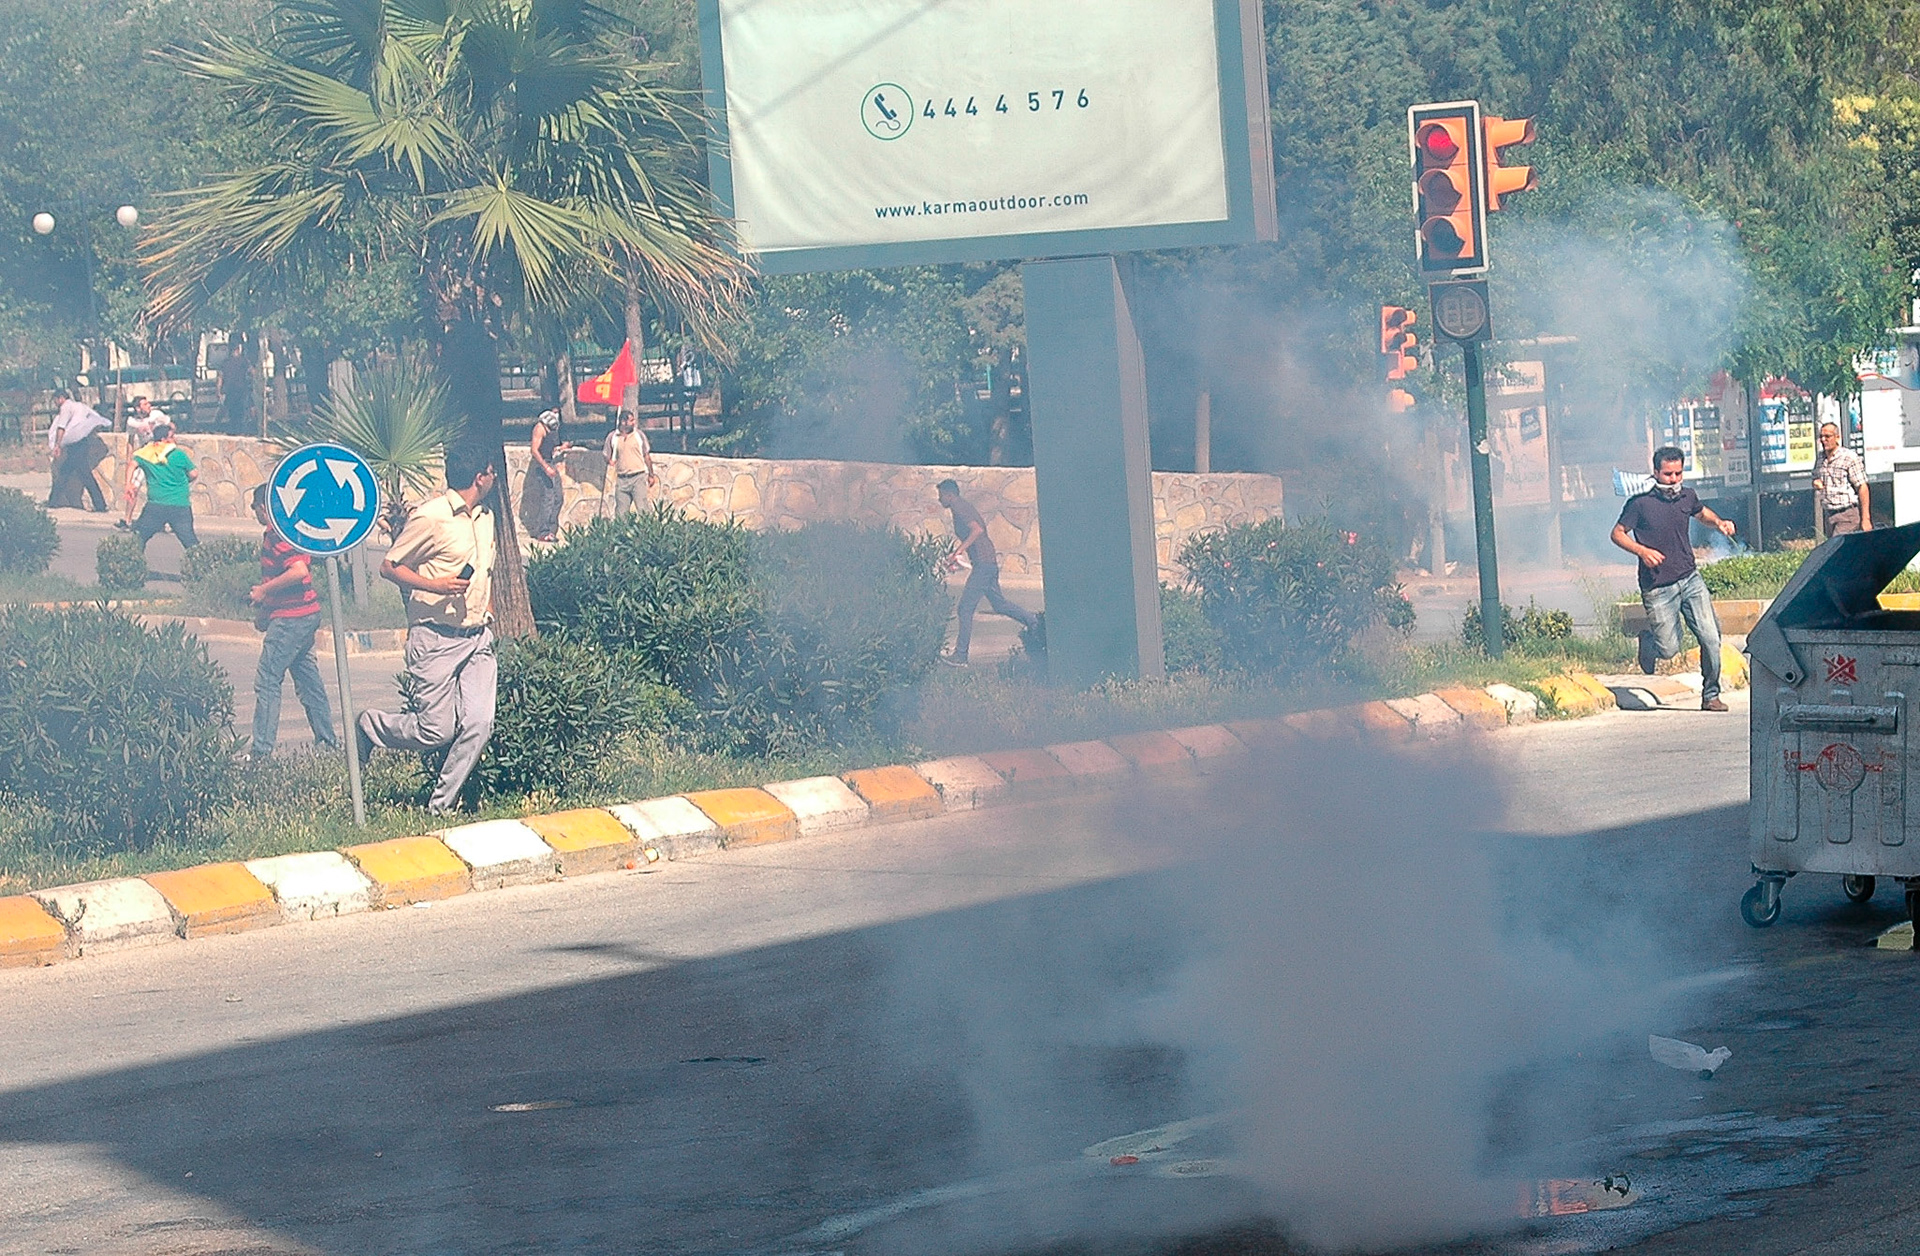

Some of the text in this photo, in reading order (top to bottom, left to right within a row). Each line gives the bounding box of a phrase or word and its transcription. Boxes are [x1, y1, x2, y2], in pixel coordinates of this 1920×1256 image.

[922, 87, 1090, 119] 444 4 576
[874, 192, 1090, 219] www.karmaoutdoor.com
